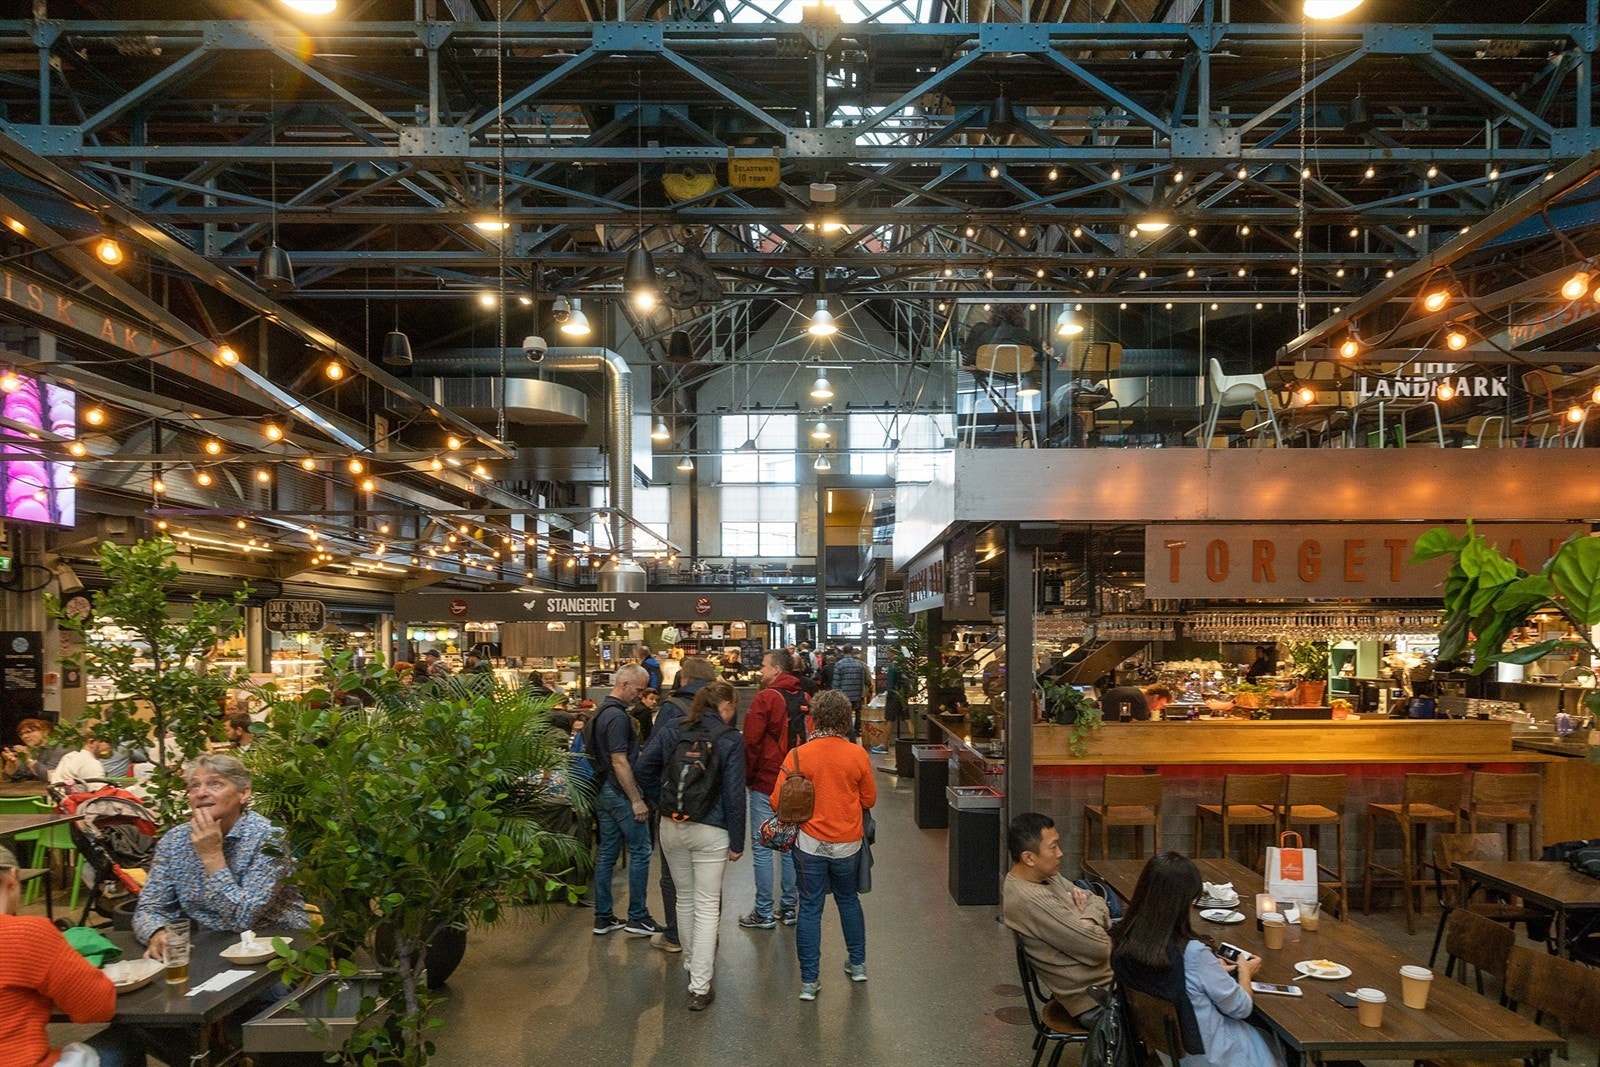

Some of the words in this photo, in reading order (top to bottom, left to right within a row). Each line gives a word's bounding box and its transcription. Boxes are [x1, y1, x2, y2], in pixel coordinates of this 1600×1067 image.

[99, 317, 241, 396] AKADEMI
[1163, 538, 1408, 583] TORGET
[547, 598, 617, 613] STANGERIET
